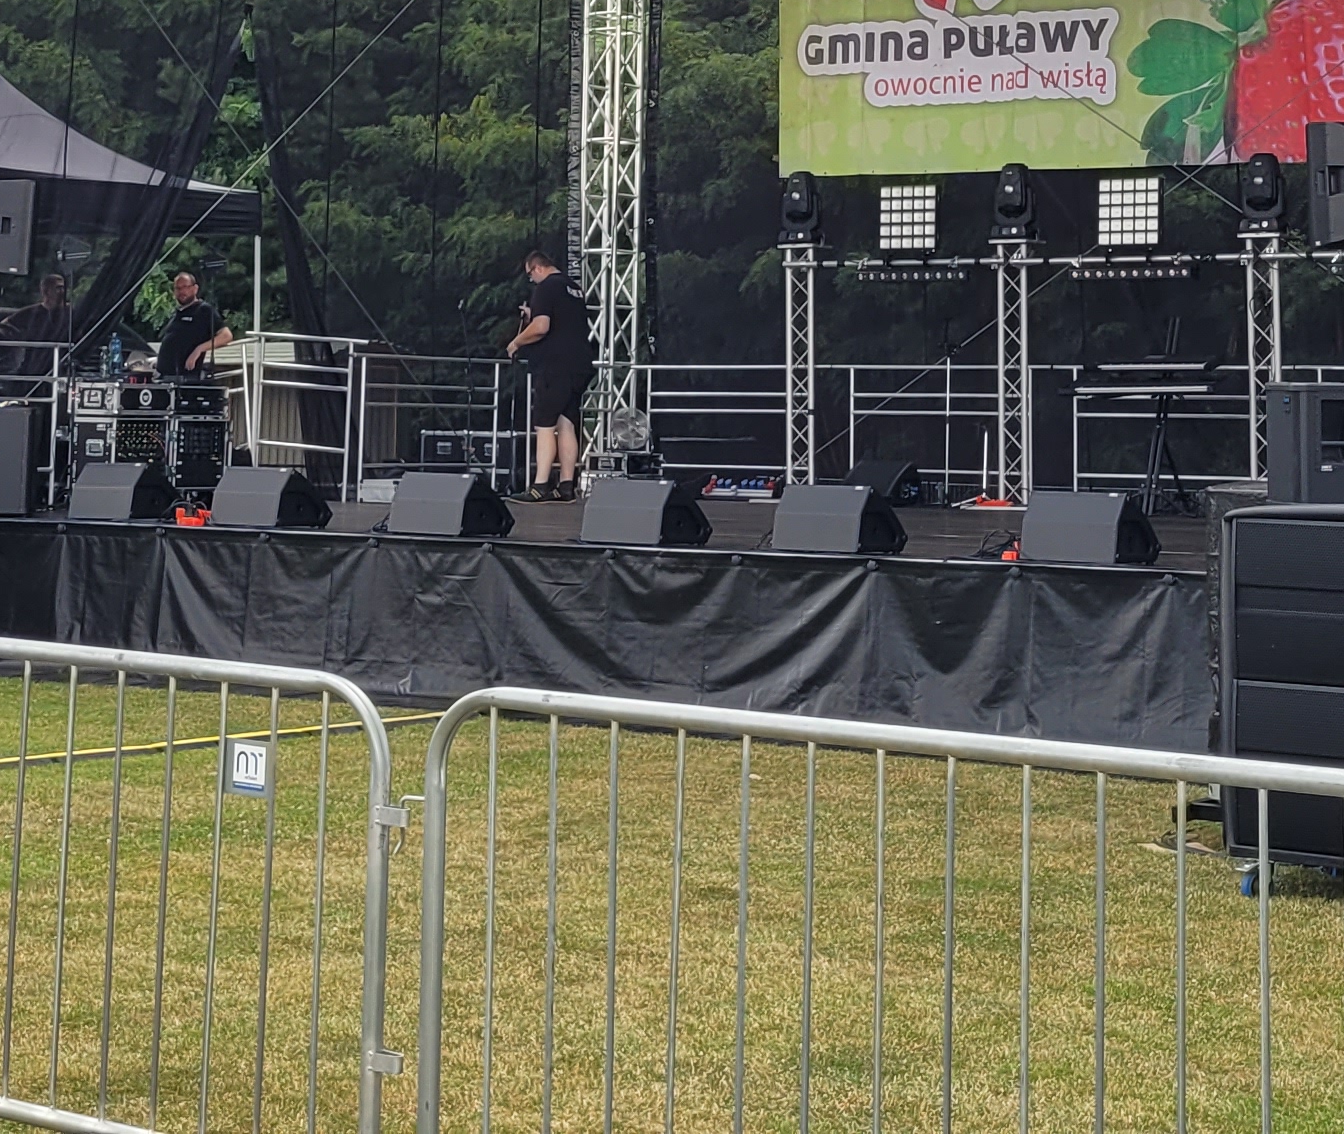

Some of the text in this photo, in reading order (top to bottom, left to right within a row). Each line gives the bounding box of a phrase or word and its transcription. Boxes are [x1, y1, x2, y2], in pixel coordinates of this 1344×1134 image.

[874, 61, 1107, 97] owocnie nad wisłą
